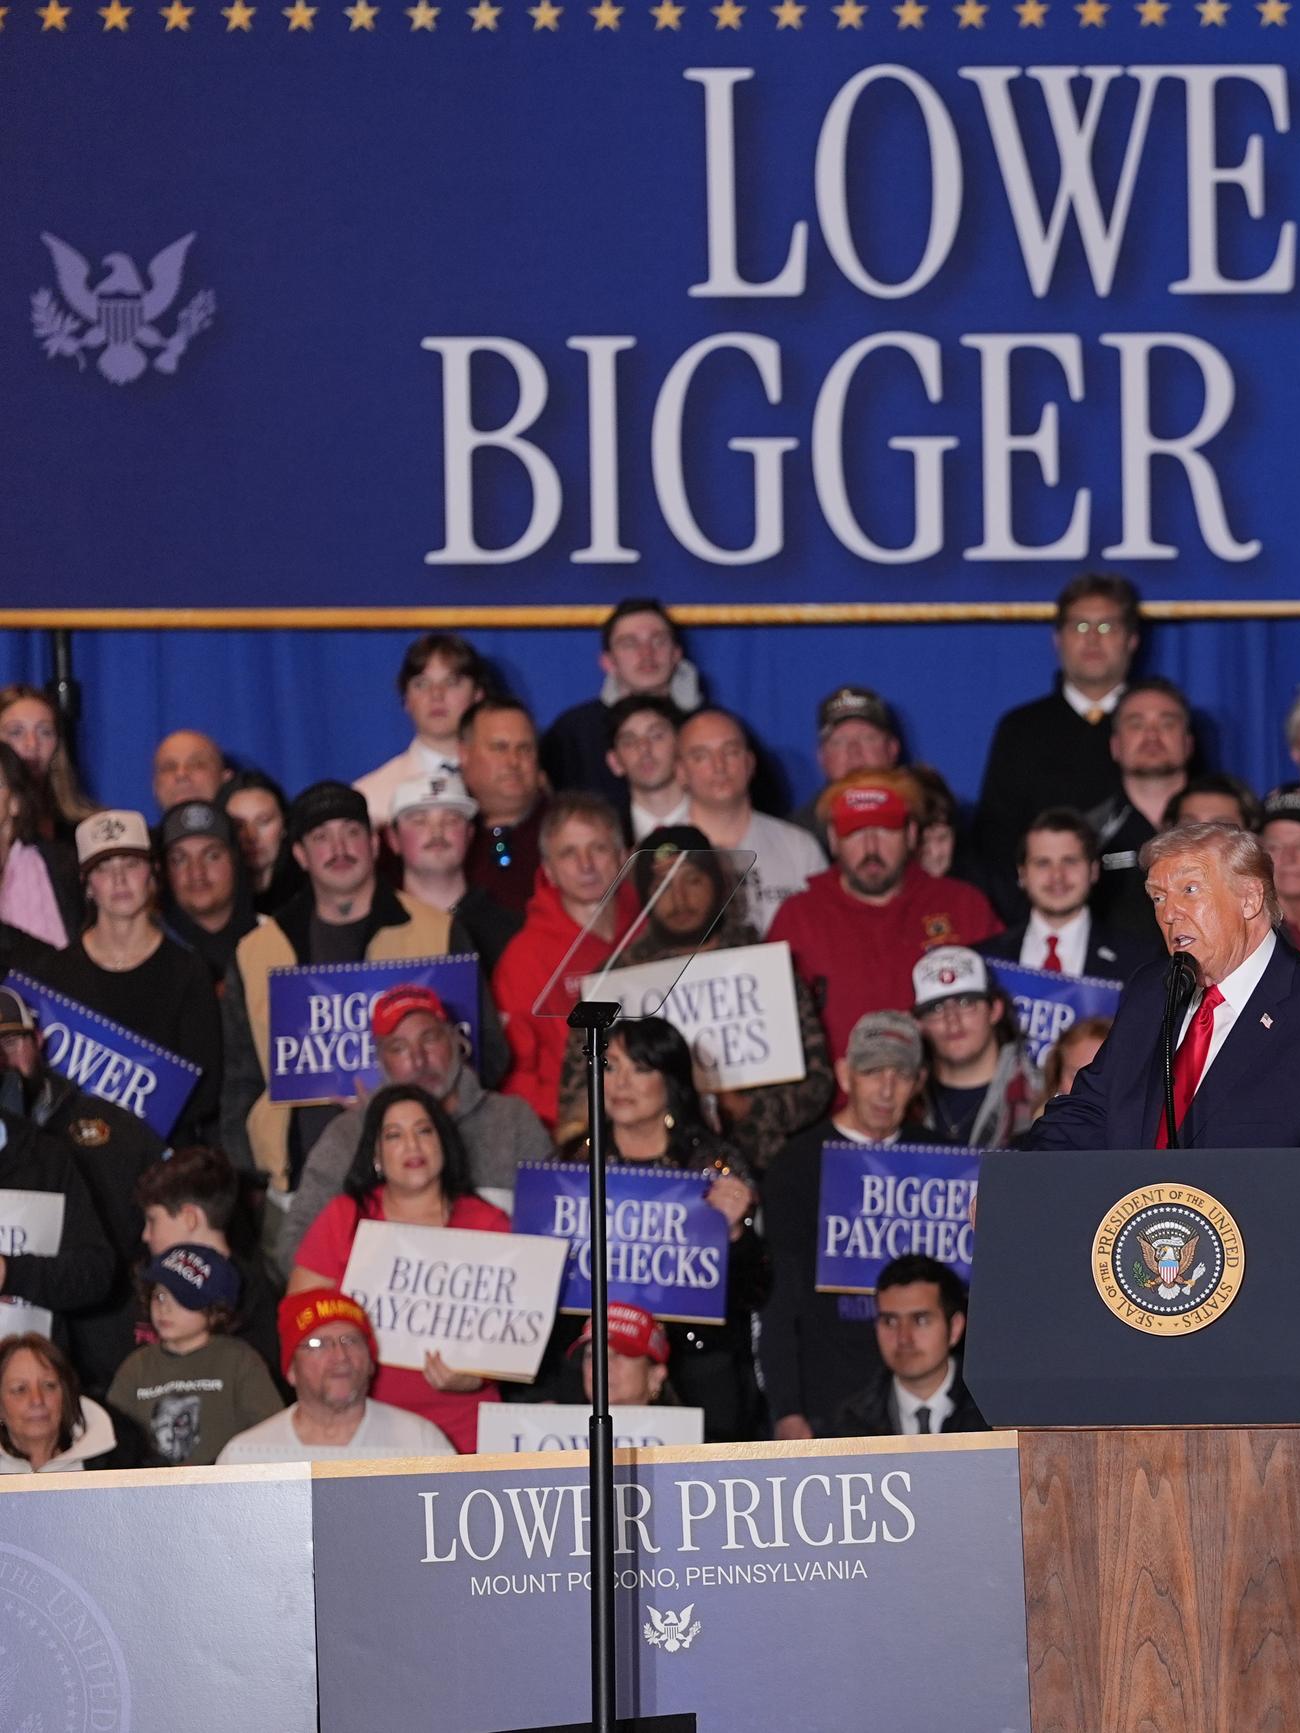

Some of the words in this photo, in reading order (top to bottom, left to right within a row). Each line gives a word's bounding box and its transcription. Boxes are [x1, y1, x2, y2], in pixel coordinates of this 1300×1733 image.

[421, 332, 1262, 565] BIGGER
[34, 1010, 158, 1119] OWER
[861, 1174, 979, 1222] BIGGE
[1169, 1190, 1183, 1200] OF
[1186, 1193, 1205, 1209] THE
[825, 1215, 975, 1265] PAYCHEC
[1097, 1188, 1165, 1256] PRESIDENT
[1208, 1206, 1240, 1268] UNITED
[387, 1256, 518, 1307] BIGGER
[1099, 1261, 1109, 1283] THE
[1105, 1285, 1117, 1298] OF
[1116, 1296, 1155, 1327] SEAL
[1181, 1281, 1233, 1327] STATES
[416, 1482, 661, 1563] LOWER
[673, 1470, 917, 1553] PRICES
[470, 1572, 562, 1596] MOUNT
[686, 1559, 869, 1587] PENNSYLVANIA
